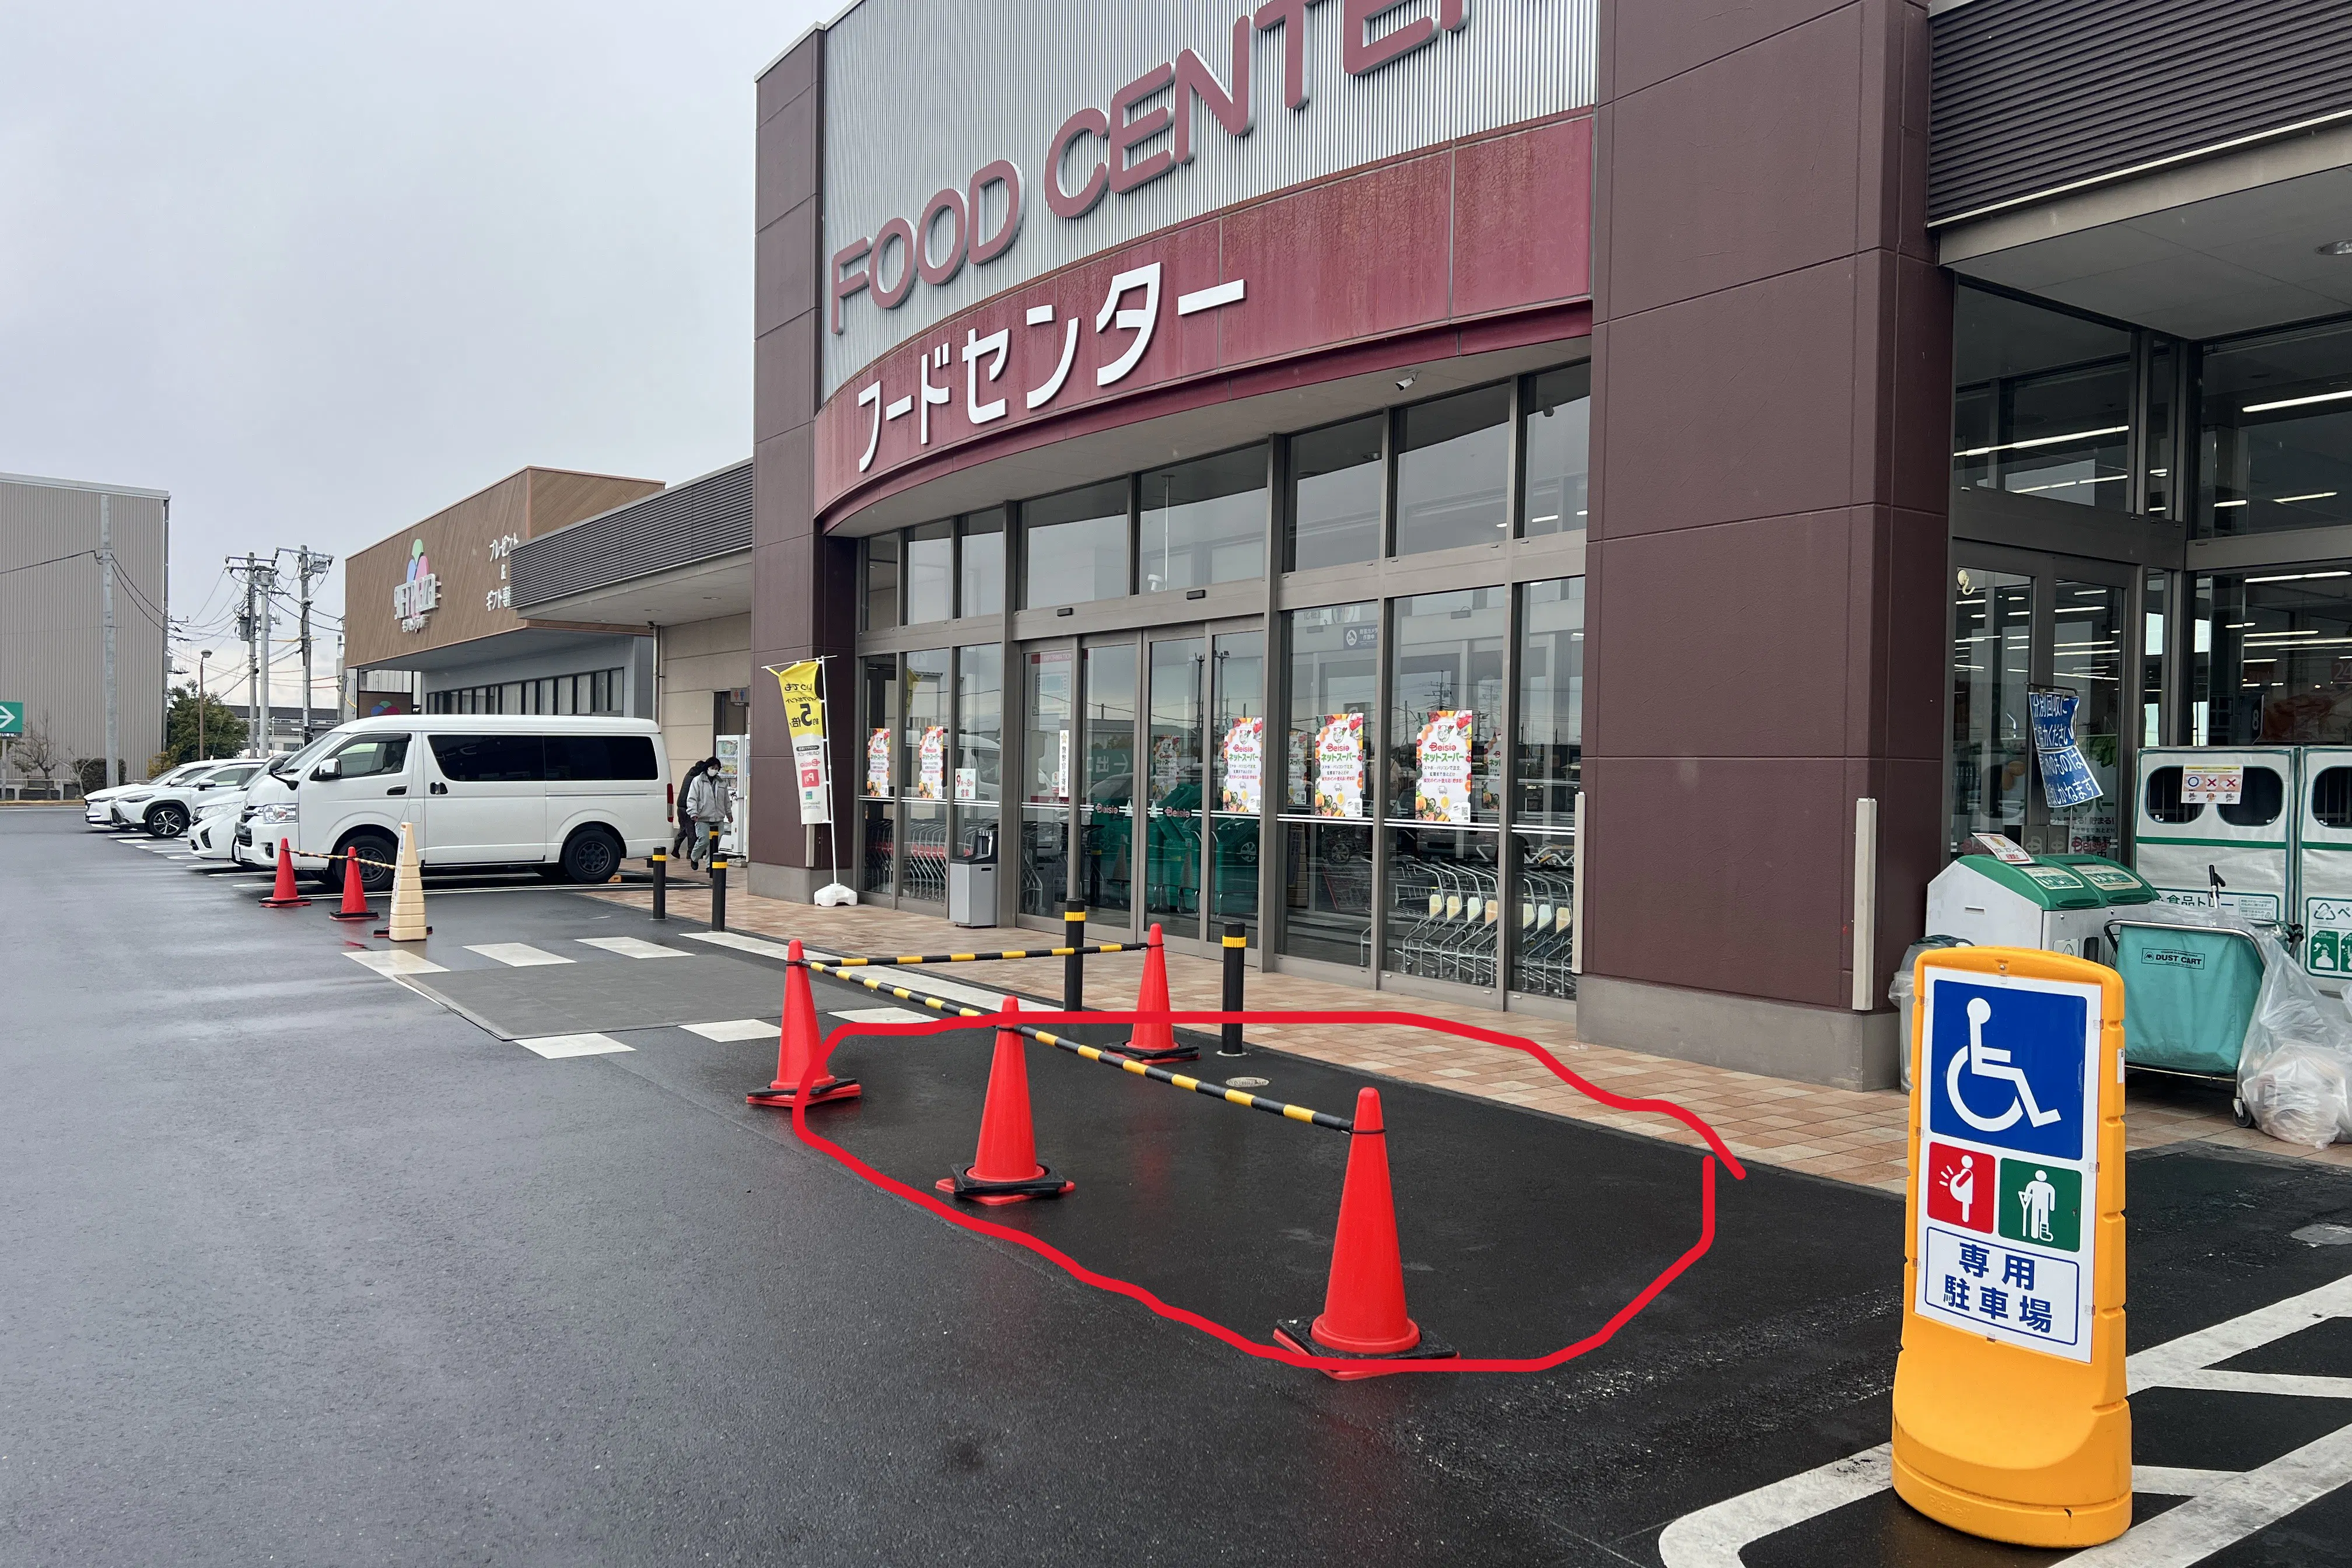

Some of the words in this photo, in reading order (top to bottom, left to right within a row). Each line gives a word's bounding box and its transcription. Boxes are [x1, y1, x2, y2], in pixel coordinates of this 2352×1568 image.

[831, 159, 1025, 335] FOOD
[1045, 0, 1470, 219] CENTE
[858, 261, 1247, 473] フードセンター
[1044, 653, 1072, 662] INFORMATION
[2033, 694, 2070, 718] 分別回収に
[1326, 743, 1349, 751] Beisia
[1429, 743, 1456, 751] Beisia
[1228, 753, 1258, 761] ネットスーパー
[1321, 752, 1356, 762] ネットスーパー
[1423, 752, 1464, 762] ネットスーパー
[1164, 806, 1190, 818] Beisia
[2155, 954, 2179, 962] DUST
[2180, 957, 2202, 965] CART
[1958, 1241, 2036, 1292] 専用
[1943, 1274, 2053, 1335] 駐車場
